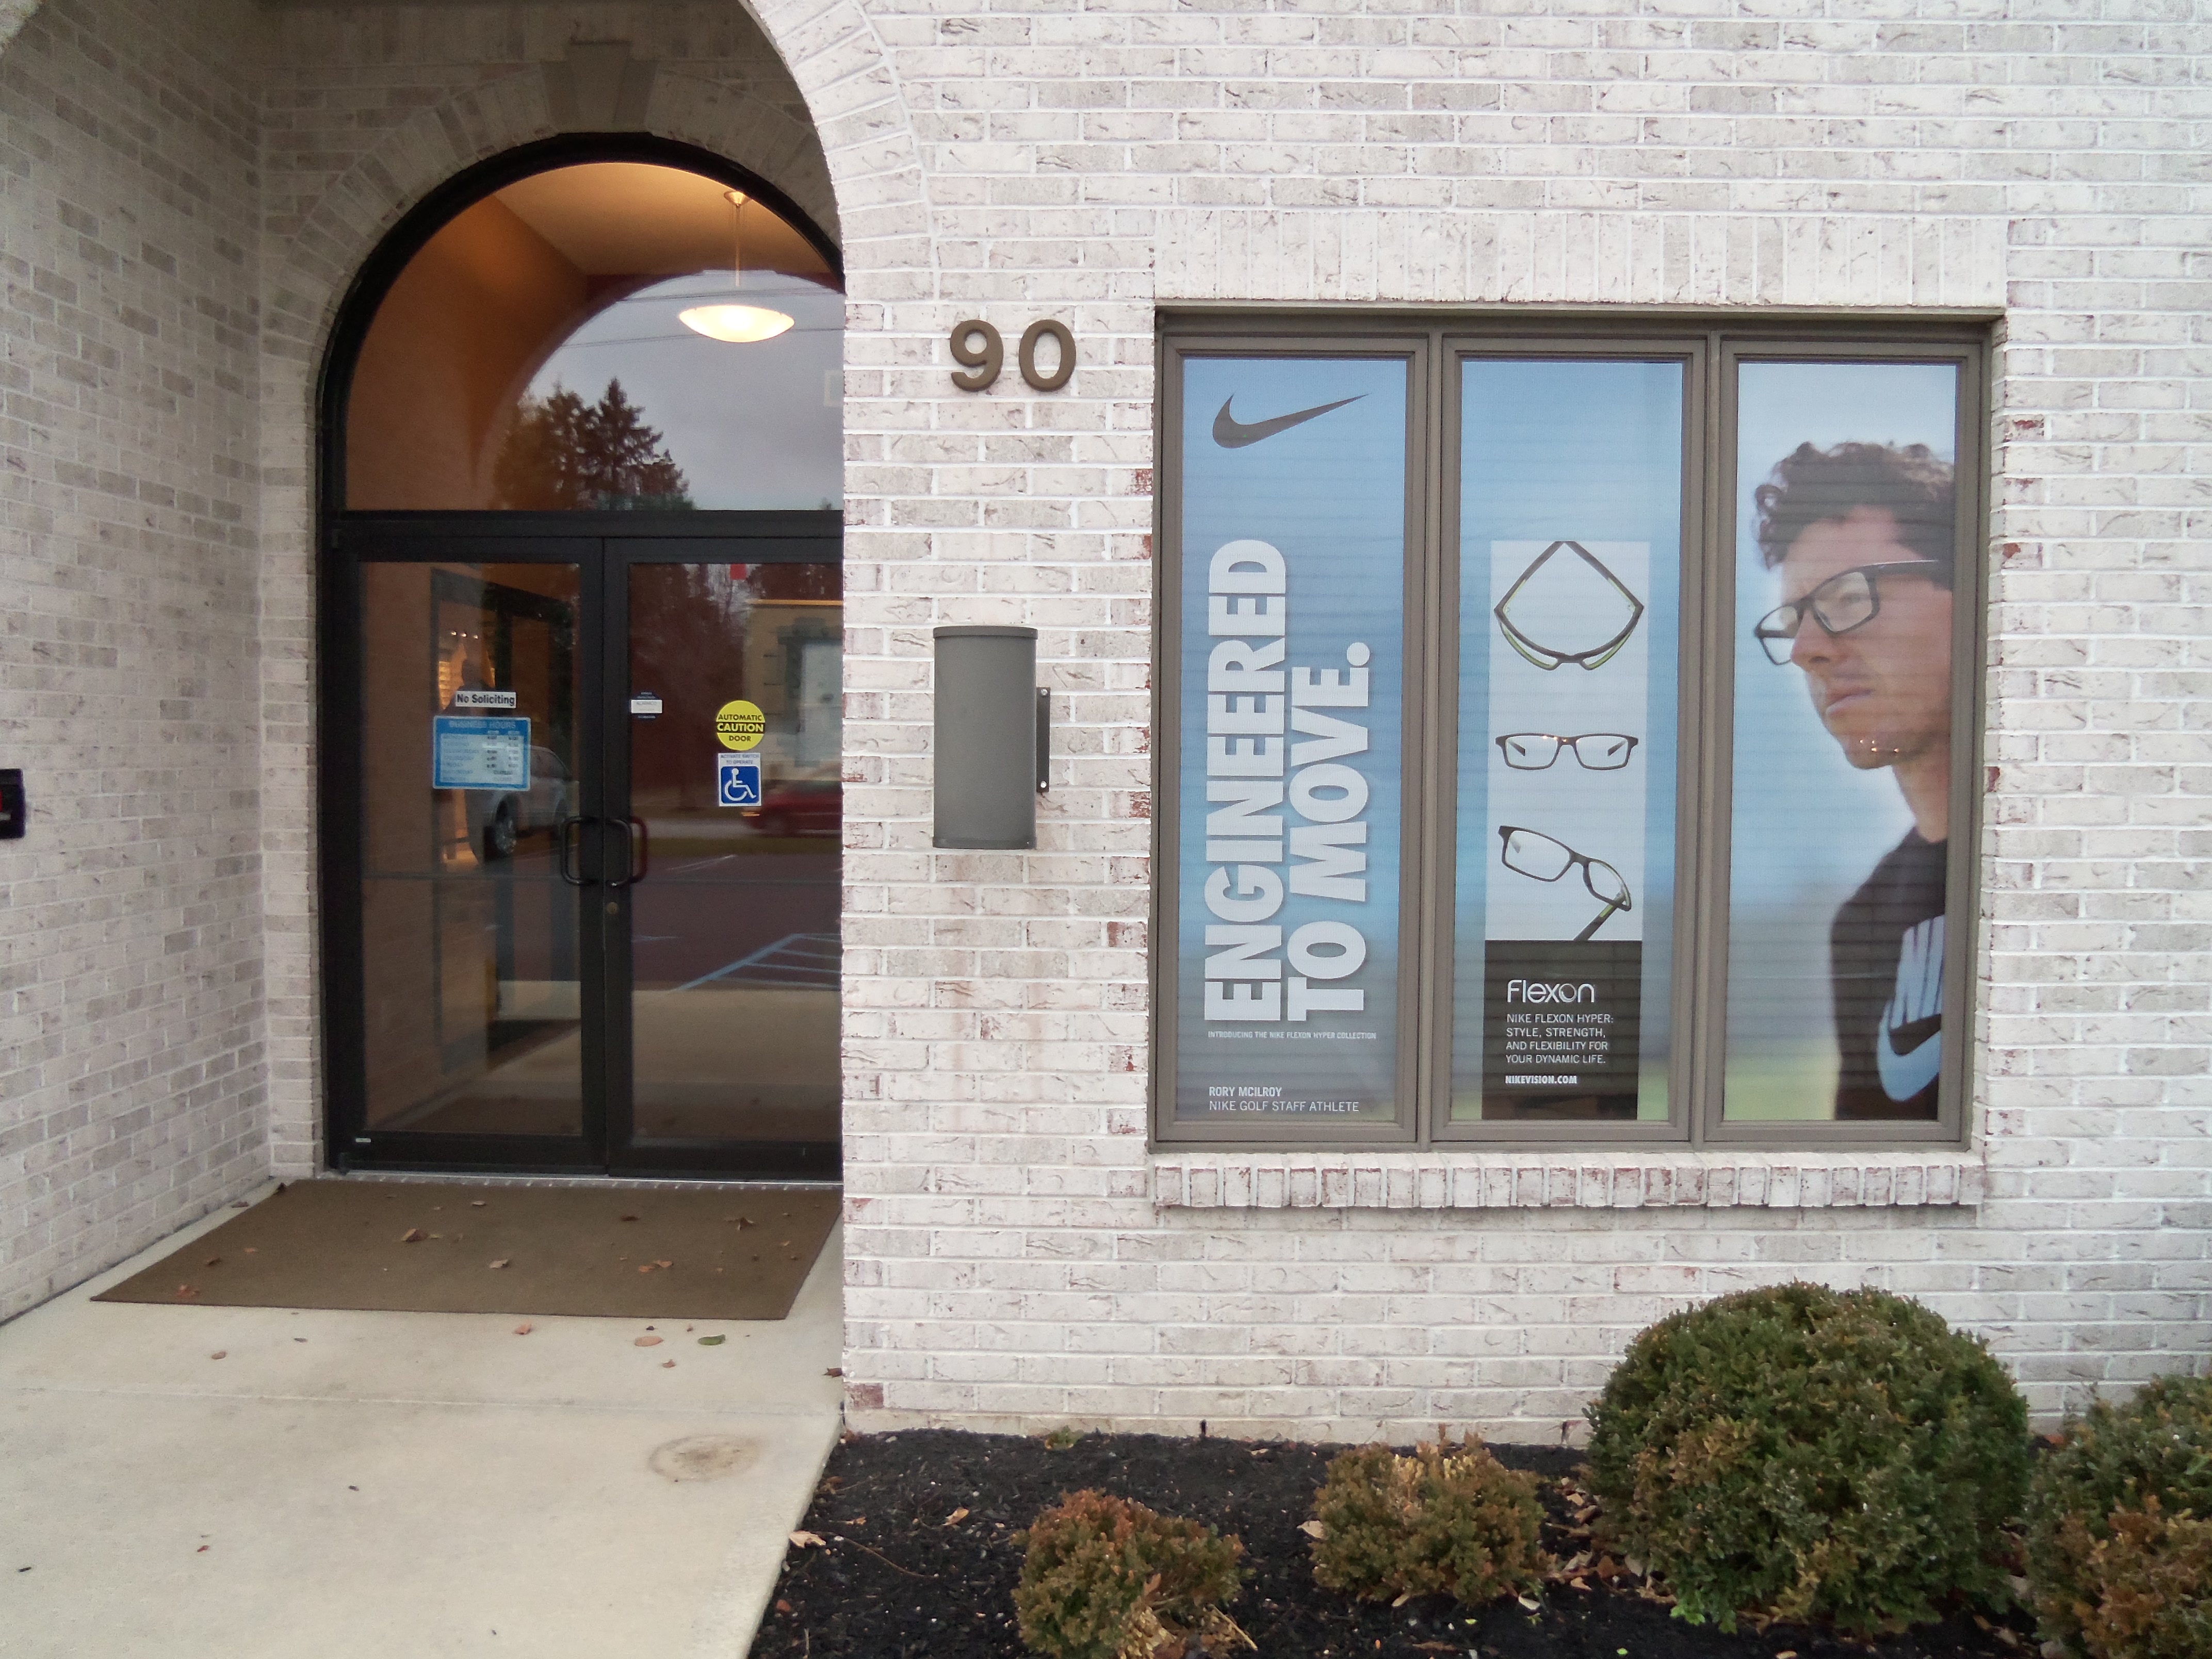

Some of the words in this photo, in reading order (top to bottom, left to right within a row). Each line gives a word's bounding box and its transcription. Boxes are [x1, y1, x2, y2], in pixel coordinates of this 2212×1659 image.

[950, 319, 1076, 392] 90
[457, 694, 469, 703] No
[471, 694, 514, 706] Soliciting
[717, 723, 763, 732] CAUTION
[1289, 642, 1371, 902] MOVE.
[1205, 540, 1286, 1021] ENGINEERED
[1287, 920, 1367, 1021] TO
[1507, 980, 1595, 1003] Flexon
[1507, 1014, 1531, 1023] NIKE
[1535, 1014, 1573, 1023] FLEXON
[1577, 1014, 1614, 1023] HYPER:
[1506, 1028, 1541, 1038] STYLE,
[1546, 1028, 1605, 1038] STRENGTH,
[1506, 1041, 1526, 1050] AND
[1530, 1041, 1585, 1050] FLEXIBILITY
[1589, 1041, 1608, 1050] FOR
[1506, 1054, 1532, 1063] YOUR
[1535, 1054, 1580, 1063] DYNAMIC
[1583, 1054, 1605, 1063] LIFE.
[1505, 1076, 1577, 1084] NIKEVISION.COM
[1209, 1086, 1235, 1097] RORY
[1239, 1086, 1282, 1097] MCILROY
[1209, 1100, 1236, 1111] NIKE
[1240, 1101, 1268, 1111] GOLF
[1272, 1101, 1306, 1111] STAFF
[1309, 1101, 1359, 1112] ATHLETE
